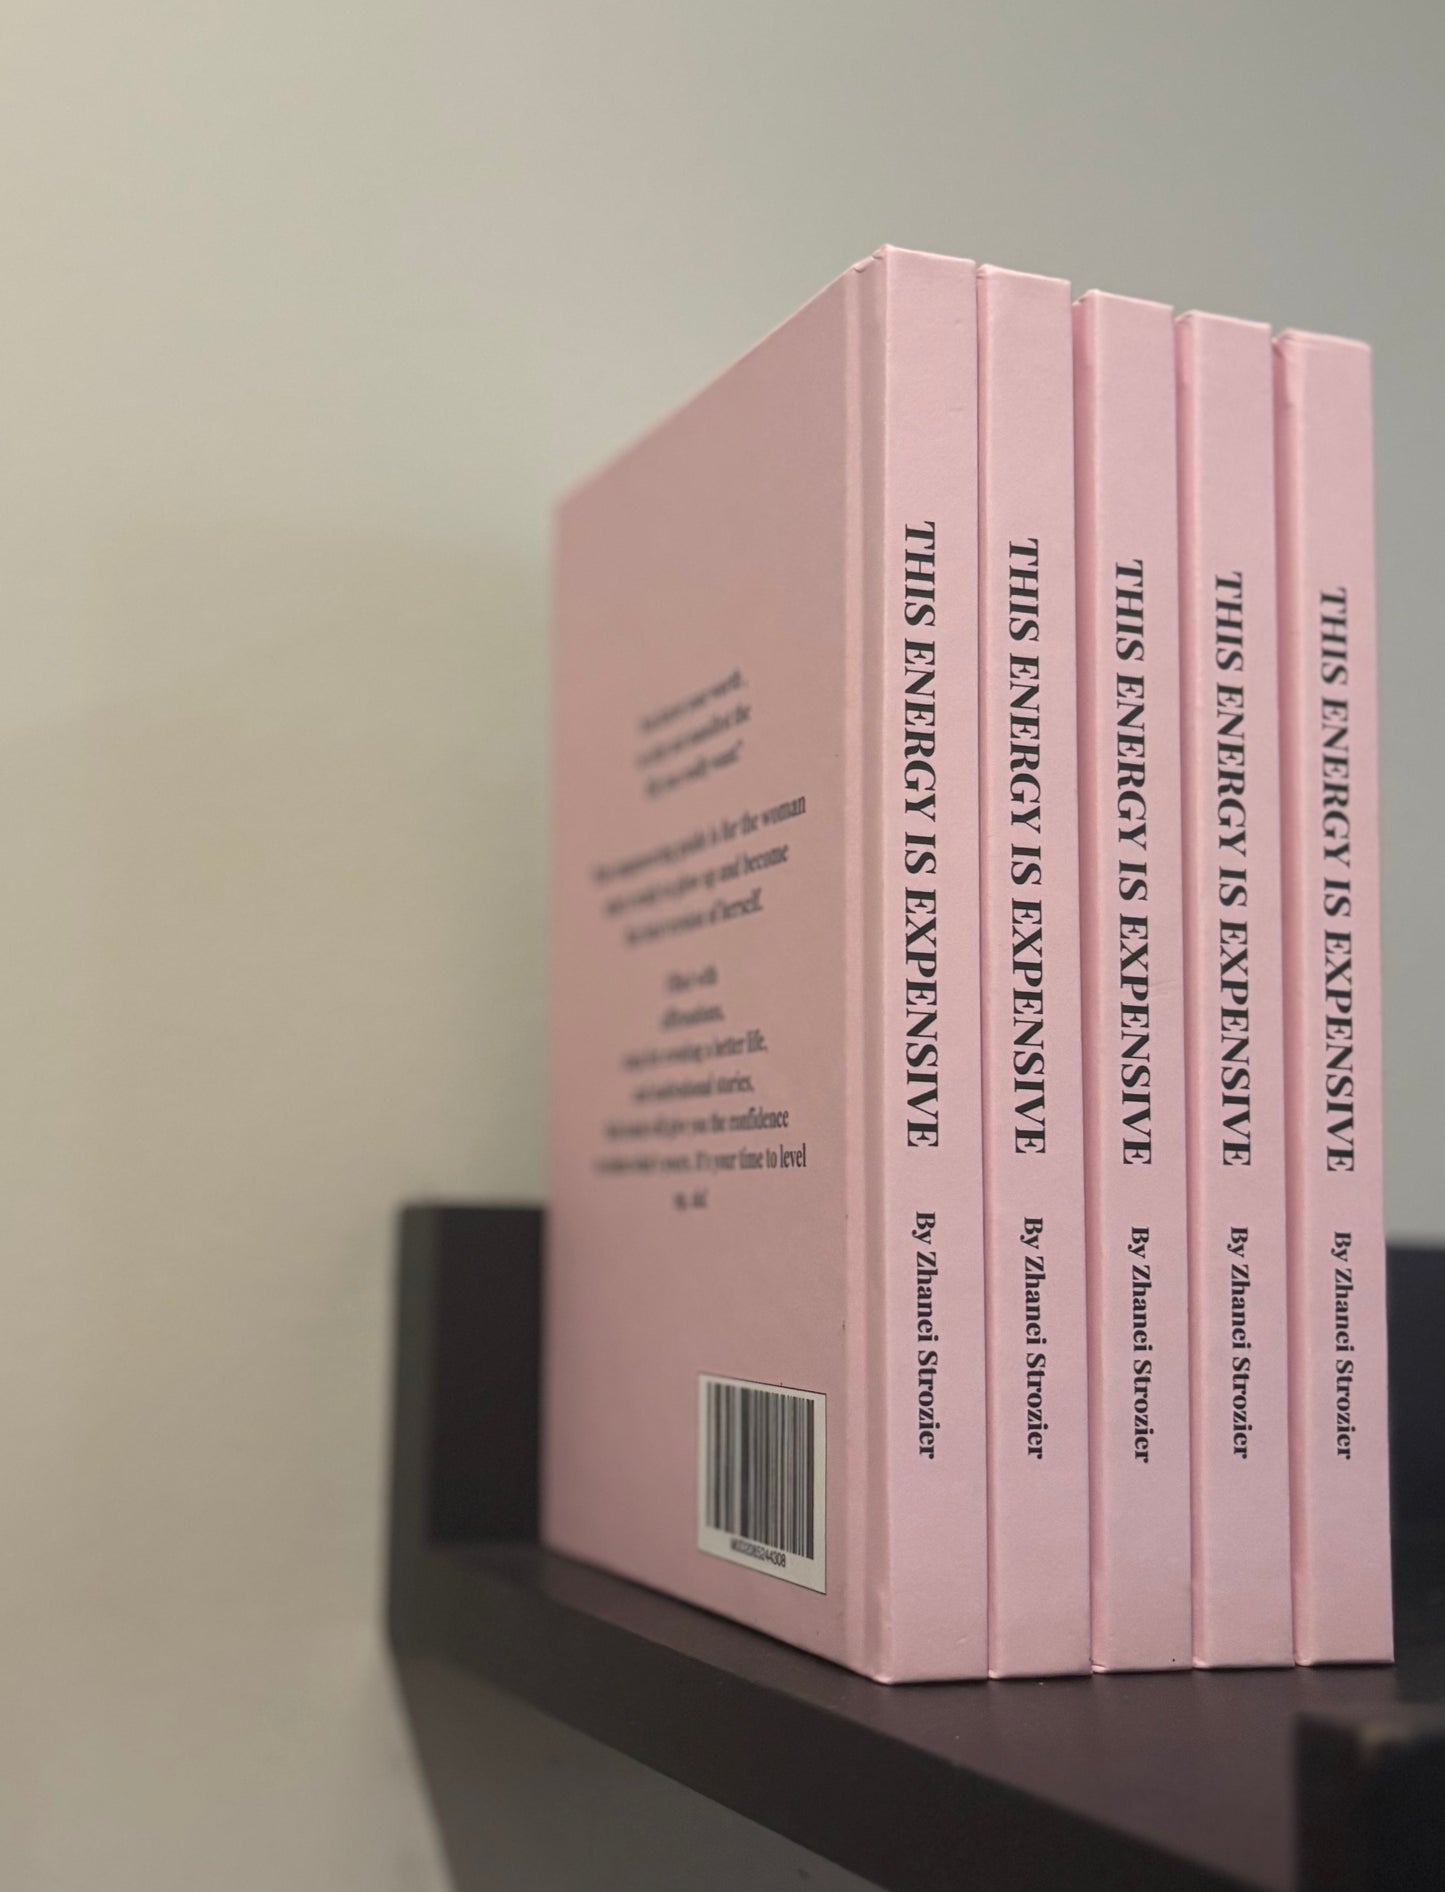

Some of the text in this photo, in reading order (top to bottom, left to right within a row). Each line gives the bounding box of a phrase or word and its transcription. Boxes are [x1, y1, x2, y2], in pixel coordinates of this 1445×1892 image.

[762, 796, 806, 826] woman
[904, 520, 939, 1147] THIS ENERGY IS EXPENSIVE
[1008, 537, 1046, 1154] THIS ENERGY IS EXPENSIVE
[1115, 559, 1152, 1165] THIS ENERGY IS EXPENSIVE
[1215, 572, 1251, 1166] THIS ENERGY IS EXPENSIVE
[1321, 587, 1355, 1172] THIS ENERGY IS EXPENSIVE
[729, 1106, 790, 1132] confidence
[765, 1147, 778, 1169] to
[779, 1142, 807, 1168] level
[911, 1211, 941, 1460] By Zhanei Strozier
[1019, 1217, 1049, 1460] By Zhanei Strozier
[1127, 1226, 1155, 1464] By Zhanei Strozier
[1226, 1226, 1253, 1460] By Zhanei Strozier
[1330, 1231, 1356, 1460] By Zhanei Strozier
